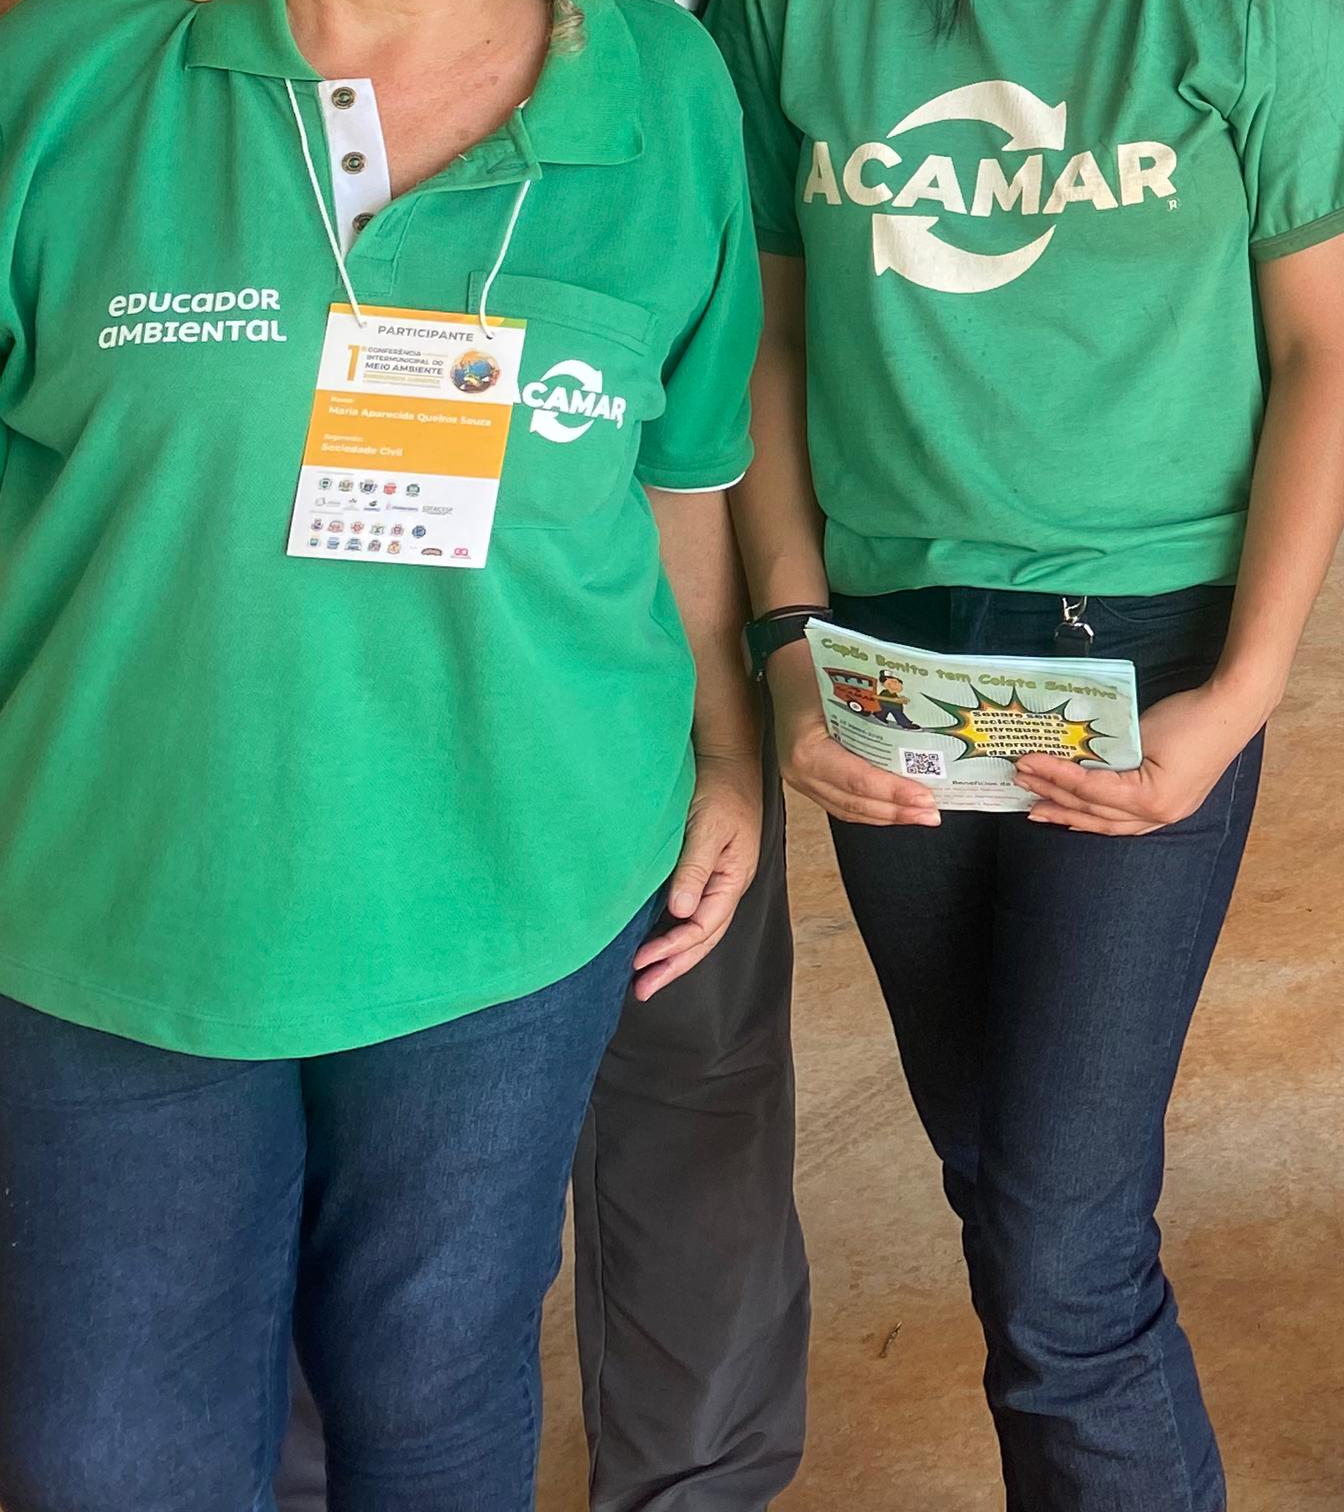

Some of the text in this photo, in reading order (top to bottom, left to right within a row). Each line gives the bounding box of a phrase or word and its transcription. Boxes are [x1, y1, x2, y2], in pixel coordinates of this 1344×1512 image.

[802, 139, 1178, 218] ACAMAR
[377, 325, 475, 342] PARTICIPANTE
[365, 362, 444, 376] MEIO AMBIENTE
[513, 379, 627, 422] CAMAR
[328, 406, 358, 417] Maria
[321, 443, 404, 457] Sociedade Civil
[821, 638, 869, 662] Capão
[875, 654, 929, 677] Bonito
[935, 669, 971, 683] tem
